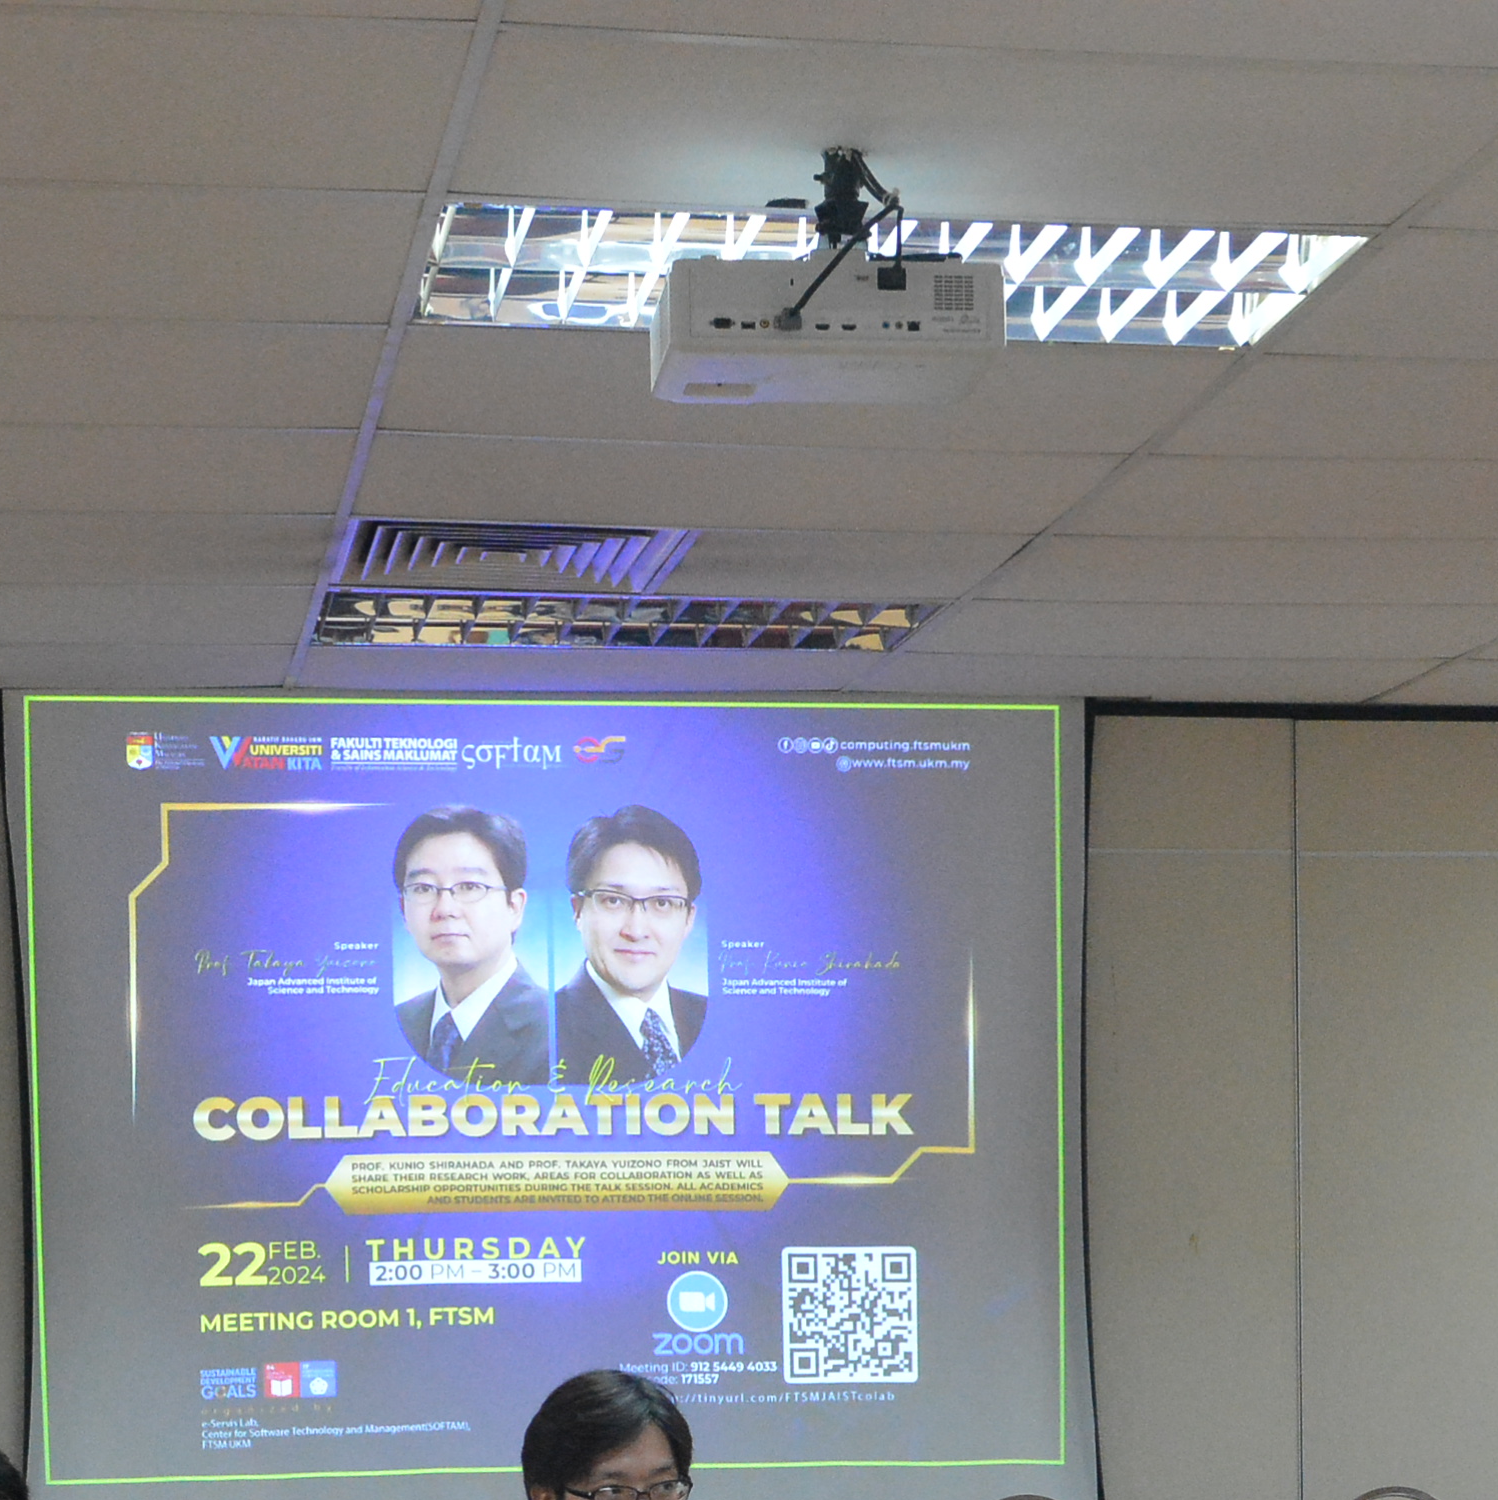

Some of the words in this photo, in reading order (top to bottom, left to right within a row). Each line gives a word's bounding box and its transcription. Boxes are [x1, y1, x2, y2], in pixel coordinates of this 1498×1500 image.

[250, 744, 323, 756] UNIVERSITI
[330, 737, 382, 749] FAKULTI
[384, 738, 458, 750] TEKNOLOGI
[840, 740, 971, 753] computing.ftsmukm
[330, 749, 341, 760] &
[343, 749, 381, 761] SAINS
[383, 750, 458, 761] MAKLUMAT
[287, 757, 322, 770] KITA
[852, 758, 970, 771] www.ftsm.ukm.my
[334, 941, 379, 951] Speaker
[721, 940, 765, 949] Speaker
[247, 977, 276, 987] Japan
[277, 977, 325, 986] Advanced
[326, 977, 365, 985] Institute
[367, 976, 377, 985] of
[721, 978, 750, 988] Japan
[751, 978, 797, 987] Advanced
[798, 978, 836, 987] Institute
[838, 978, 848, 987] of
[267, 986, 304, 995] Science
[305, 986, 324, 995] and
[325, 986, 380, 996] Technology
[721, 987, 757, 996] Science
[759, 987, 776, 996] and
[778, 987, 831, 997] Technology
[364, 1056, 531, 1107] Education
[585, 1053, 743, 1106] Research
[192, 1092, 736, 1142] COLLABORATION
[752, 1091, 915, 1137] TALK
[352, 1162, 385, 1172] PROF.
[389, 1161, 425, 1170] KUNIO
[429, 1160, 494, 1170] SHIRAHADA
[500, 1160, 524, 1169] AND
[528, 1160, 561, 1169] PROF.
[565, 1160, 607, 1169] TAKAYA
[612, 1160, 662, 1169] YUIZONO
[666, 1159, 698, 1168] FROM
[702, 1159, 731, 1168] JAIST
[736, 1159, 763, 1168] WILL
[351, 1174, 388, 1183] SHARE
[393, 1173, 425, 1182] THEIR
[429, 1172, 489, 1182] RESEARCH
[492, 1172, 530, 1182] WORK,
[534, 1171, 570, 1181] AREAS
[574, 1171, 596, 1180] FOR
[600, 1171, 693, 1180] COLLABORATION
[696, 1171, 711, 1180] AS
[715, 1171, 745, 1180] WELL
[749, 1171, 763, 1180] AS
[351, 1185, 430, 1195] SCHOLARSHIP
[433, 1184, 521, 1193] OPPORTUNITIES
[525, 1183, 568, 1193] DURING
[571, 1183, 592, 1192] THE
[595, 1183, 622, 1192] TALK
[625, 1182, 674, 1192] SESSION.
[677, 1182, 696, 1191] ALL
[699, 1182, 764, 1191] ACADEMICS
[427, 1196, 451, 1205] AND
[453, 1195, 512, 1205] STUDENTS
[513, 1195, 536, 1204] ARE
[538, 1194, 584, 1204] INVITED
[586, 1194, 599, 1203] TO
[602, 1194, 645, 1203] ATTEND
[648, 1194, 669, 1203] THE
[671, 1194, 711, 1203] ONLINE
[715, 1193, 764, 1202] SESSION.
[365, 1236, 586, 1262] THURSDAY
[198, 1242, 268, 1286] 22
[269, 1241, 320, 1260] FEB.
[657, 1252, 700, 1265] JOIN
[706, 1251, 739, 1265] VIA
[268, 1265, 326, 1286] 2024
[375, 1265, 423, 1282] 2:00
[431, 1265, 465, 1280] PM
[488, 1264, 535, 1280] 3:00
[543, 1263, 576, 1279] PM
[200, 1311, 314, 1333] MEETING
[321, 1309, 400, 1330] ROOM
[406, 1308, 422, 1330] 1,
[429, 1307, 495, 1327] FTSM
[652, 1332, 745, 1357] zoom
[200, 1368, 257, 1377] SUSTAINABLE
[619, 1363, 669, 1374] Meeting
[672, 1362, 688, 1372] ID:
[690, 1361, 710, 1372] 912
[713, 1361, 744, 1372] 5449
[747, 1361, 778, 1372] 4033
[200, 1377, 257, 1385] DEVELOPMENT
[681, 1373, 720, 1384] 171557
[201, 1384, 257, 1400] GOALS
[201, 1430, 232, 1439] Center
[234, 1429, 247, 1438] for
[249, 1428, 290, 1438] Software
[292, 1426, 344, 1437] Technology
[345, 1425, 362, 1434] and
